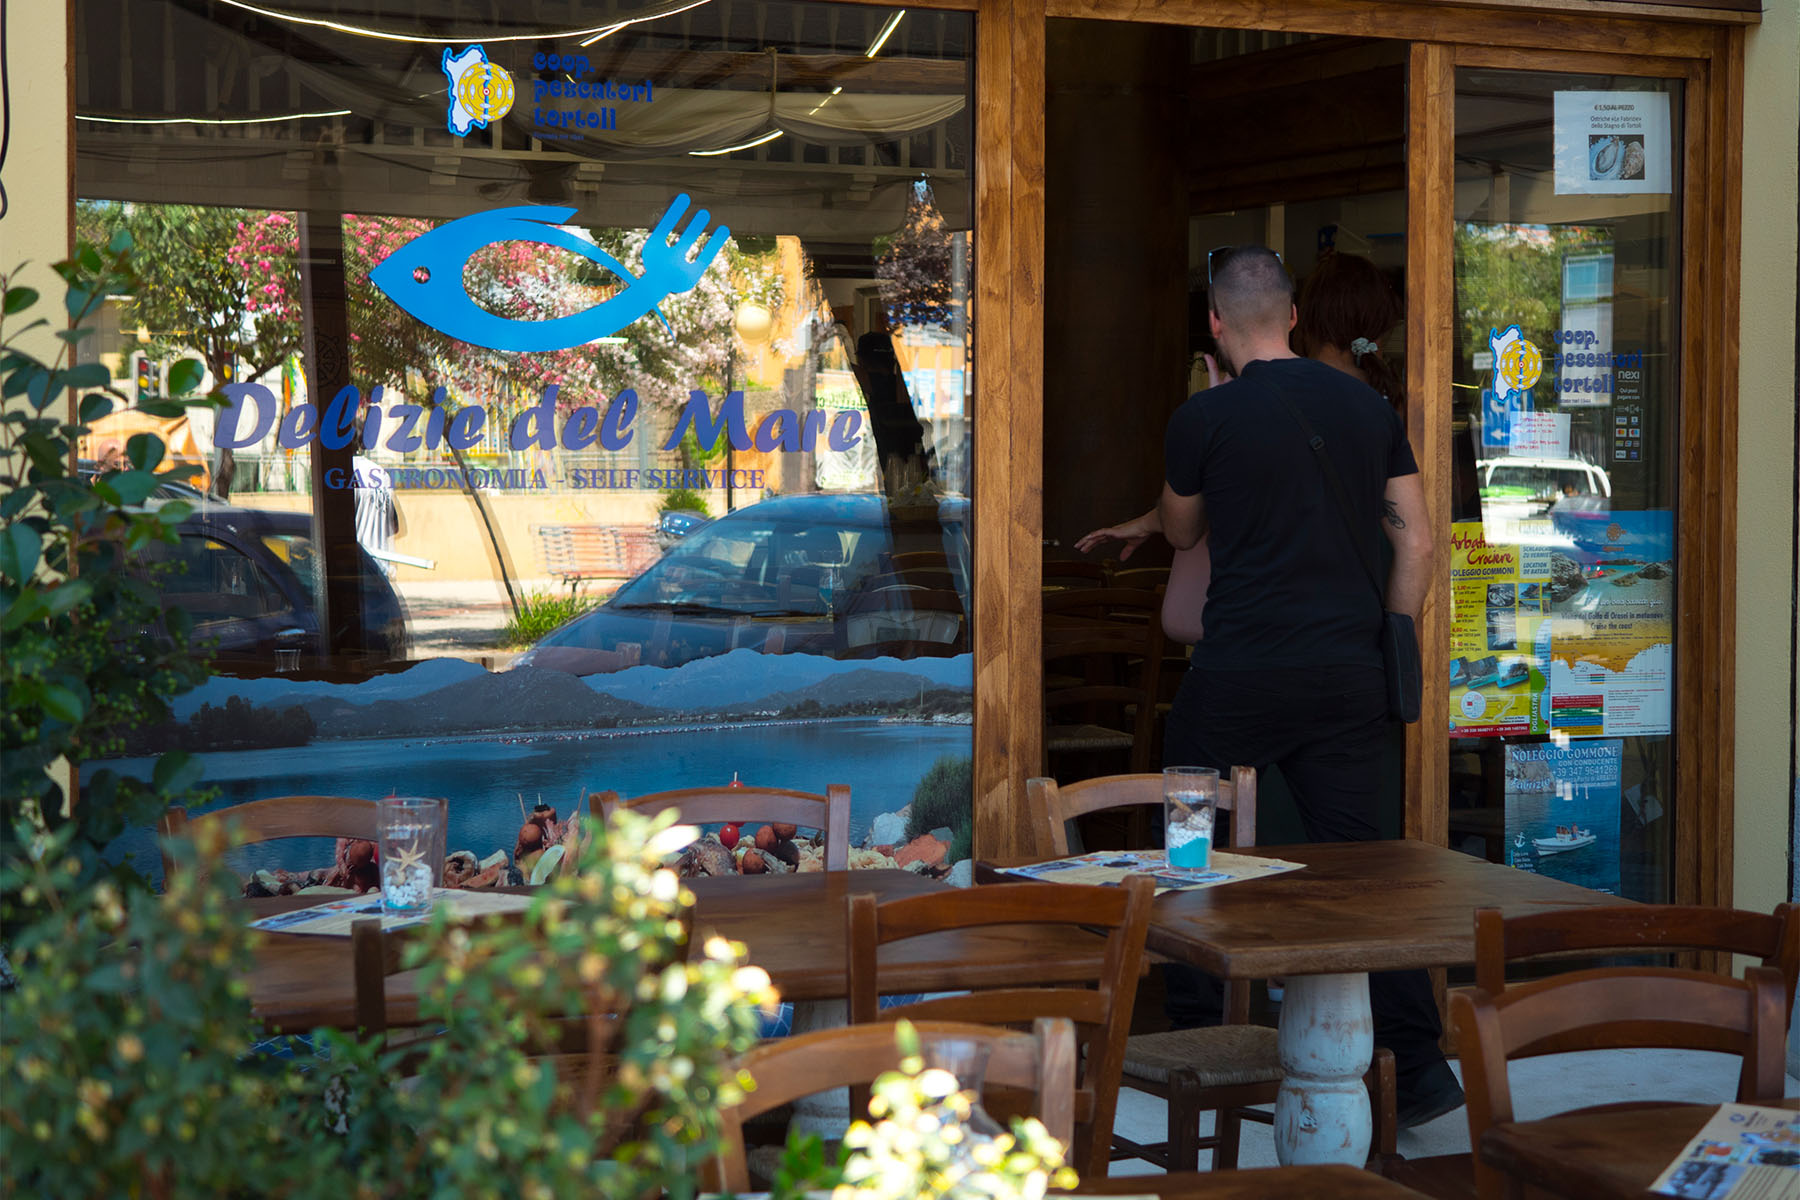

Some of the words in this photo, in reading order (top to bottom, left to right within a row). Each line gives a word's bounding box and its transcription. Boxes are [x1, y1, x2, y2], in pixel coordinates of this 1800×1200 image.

[533, 52, 595, 78] coop.
[533, 80, 653, 103] pescatori
[1553, 329, 1600, 350] coop.
[1553, 349, 1643, 373] pescatori
[1618, 370, 1640, 379] nexi
[213, 382, 486, 453] Delizie
[511, 384, 638, 452] del
[663, 388, 863, 452] Mare
[324, 468, 548, 489] GASTRONOMIA
[573, 468, 640, 489] SELF
[649, 468, 765, 490] SERVICE
[1467, 548, 1514, 565] Crociere
[1482, 567, 1515, 576] GOMMONI
[1590, 622, 1607, 630] Cruise
[1608, 622, 1617, 630] the
[1531, 692, 1539, 732] OGLIASTRA
[1511, 749, 1564, 762] NOLEGGIO
[1566, 746, 1617, 759] GOMMONE
[1574, 758, 1618, 766] CONDUCENTE
[1552, 767, 1566, 777] +39
[1568, 766, 1582, 776] 347
